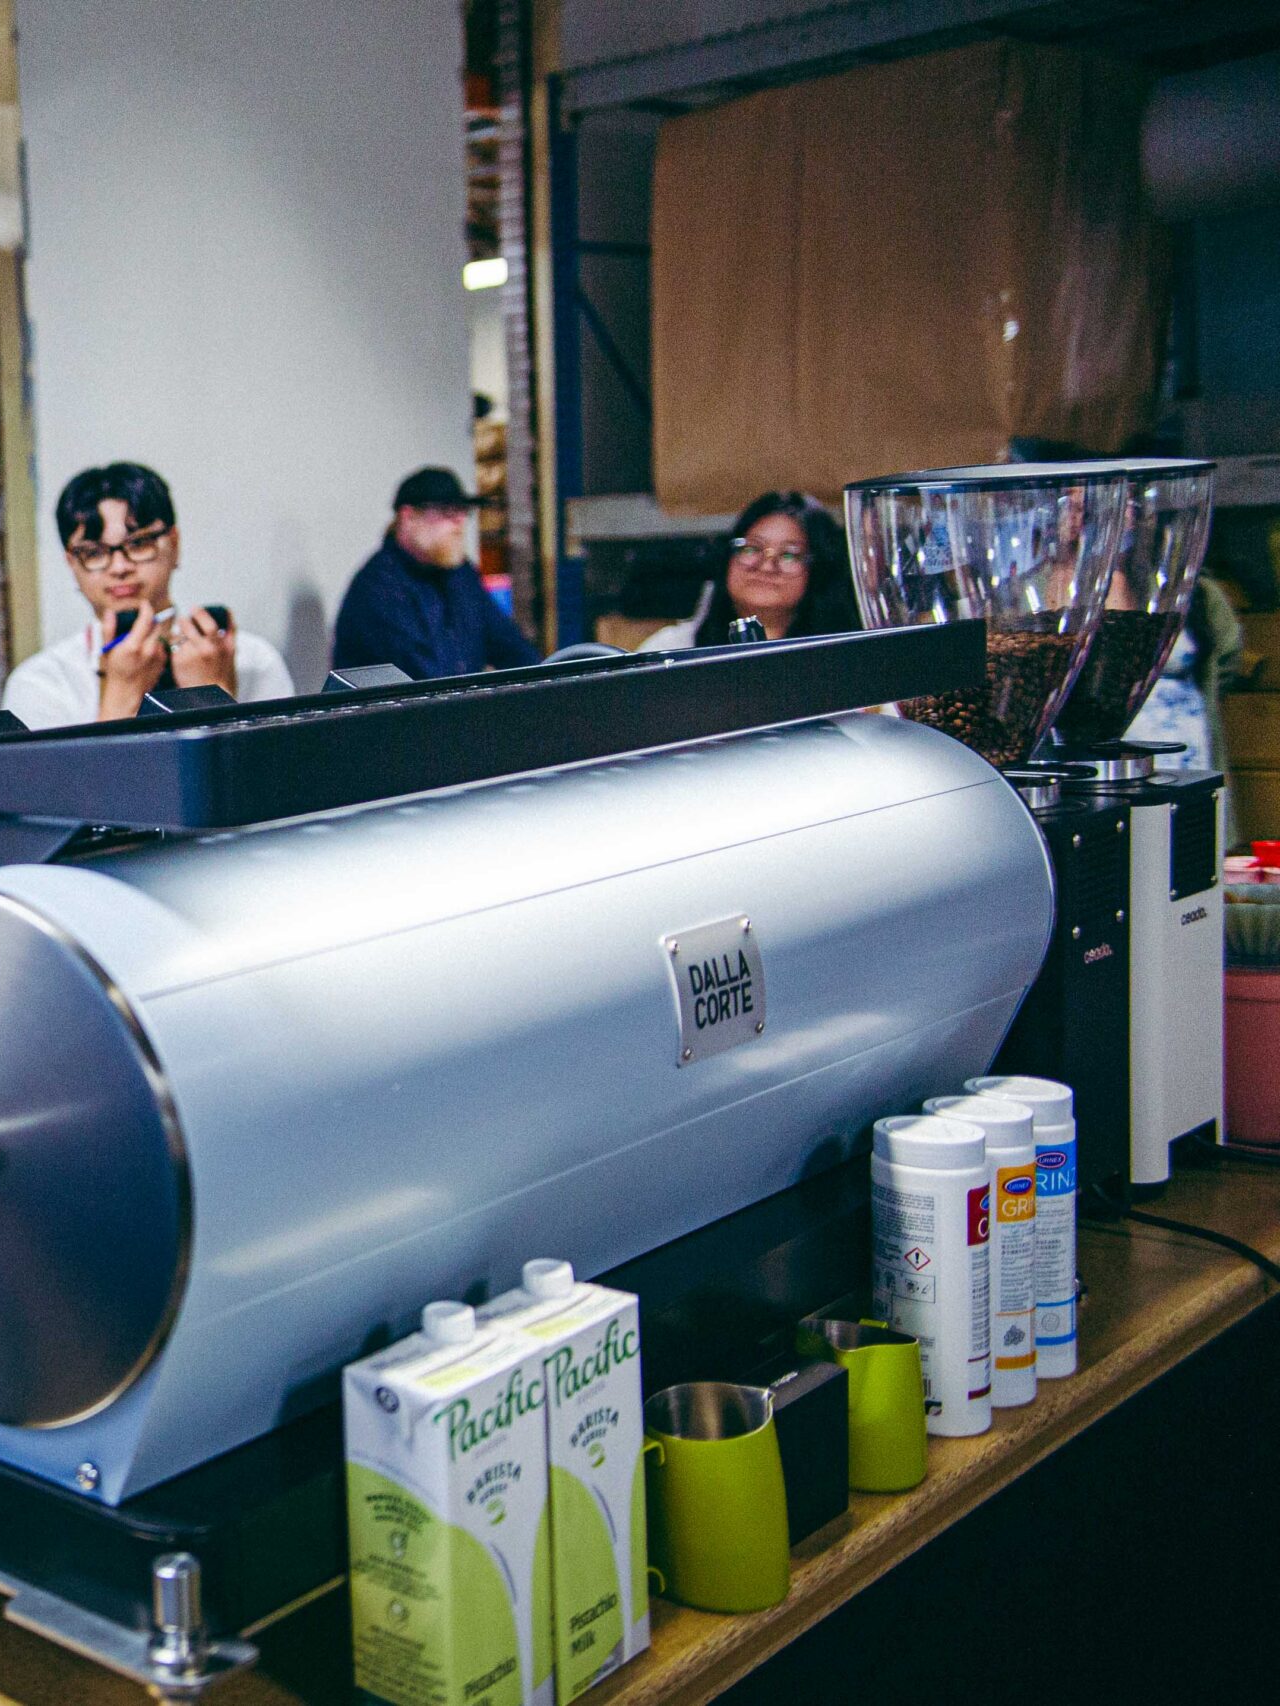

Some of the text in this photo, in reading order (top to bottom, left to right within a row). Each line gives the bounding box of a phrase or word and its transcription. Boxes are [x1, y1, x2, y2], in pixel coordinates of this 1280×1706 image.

[688, 949, 751, 996] DALLA
[694, 981, 754, 1030] CORTE
[544, 1318, 641, 1408] Pacific
[433, 1368, 547, 1464] Pacific
[571, 1631, 596, 1657] Milk
